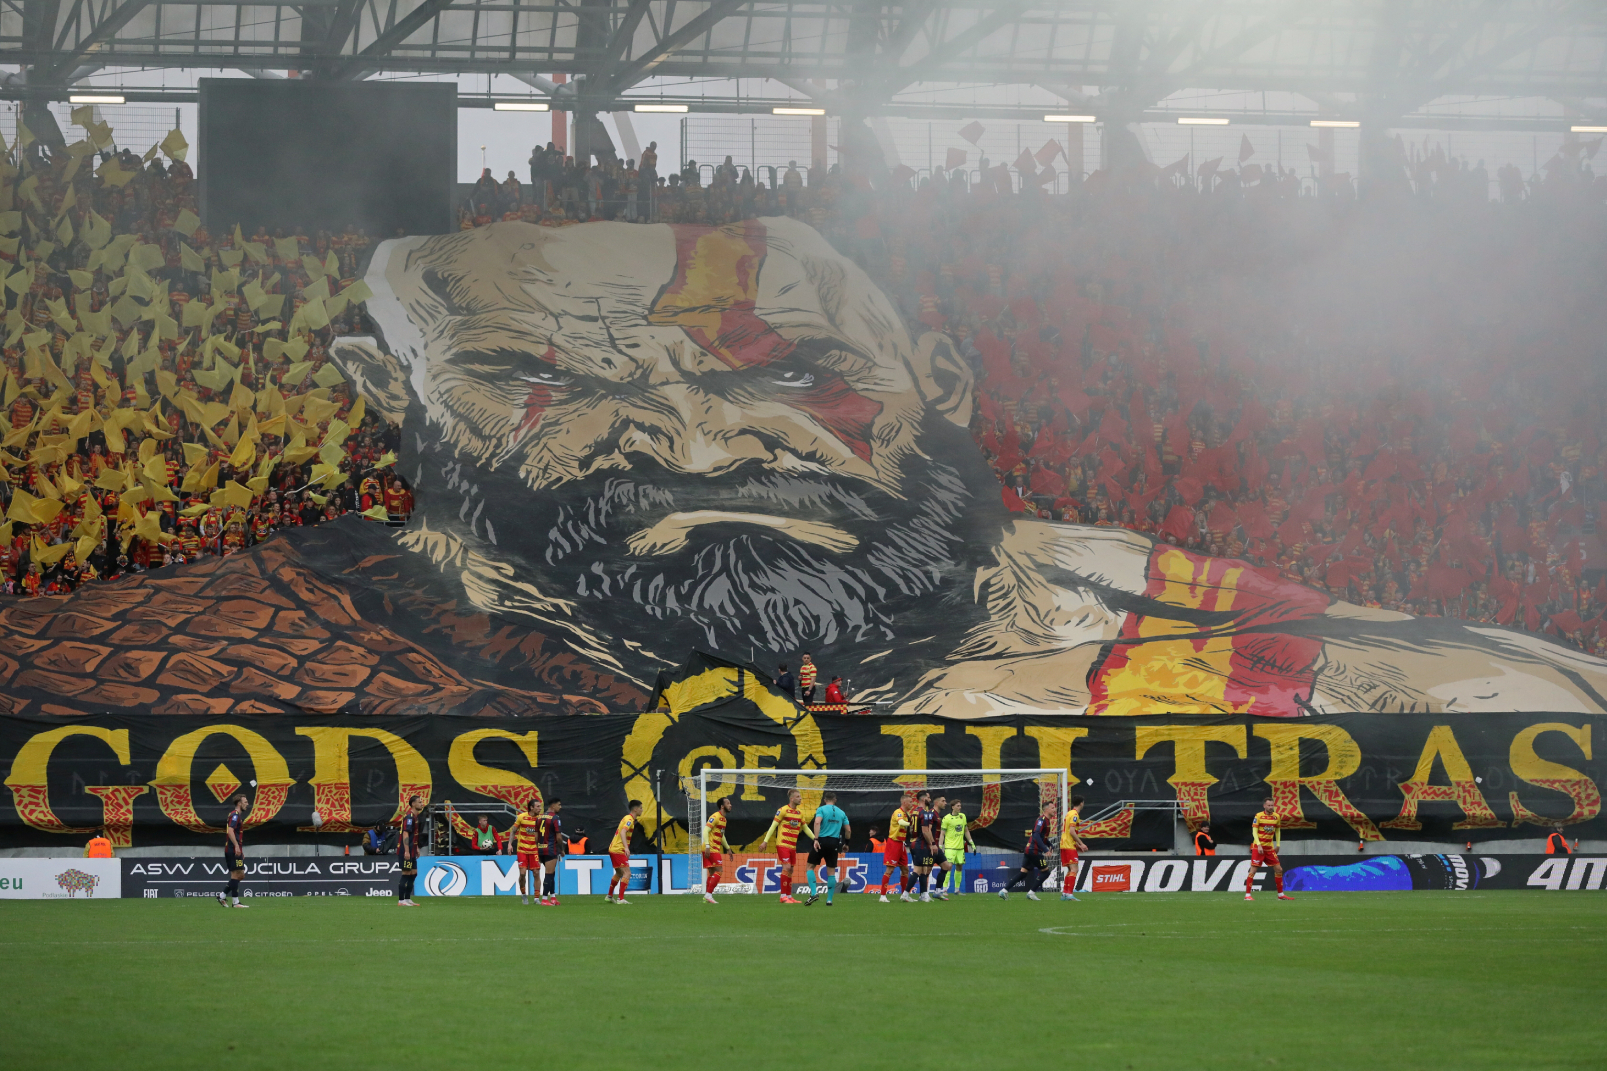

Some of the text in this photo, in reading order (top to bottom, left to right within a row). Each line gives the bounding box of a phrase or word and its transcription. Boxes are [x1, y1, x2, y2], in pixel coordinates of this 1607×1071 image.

[4, 722, 1602, 847] GODS OF ULTRAS
[130, 863, 195, 875] ASW
[329, 862, 402, 874] GRUPA
[1096, 873, 1126, 883] STIHL
[143, 888, 159, 899] FIAT
[365, 887, 393, 897] Jeep
[796, 885, 829, 894] FRGO
